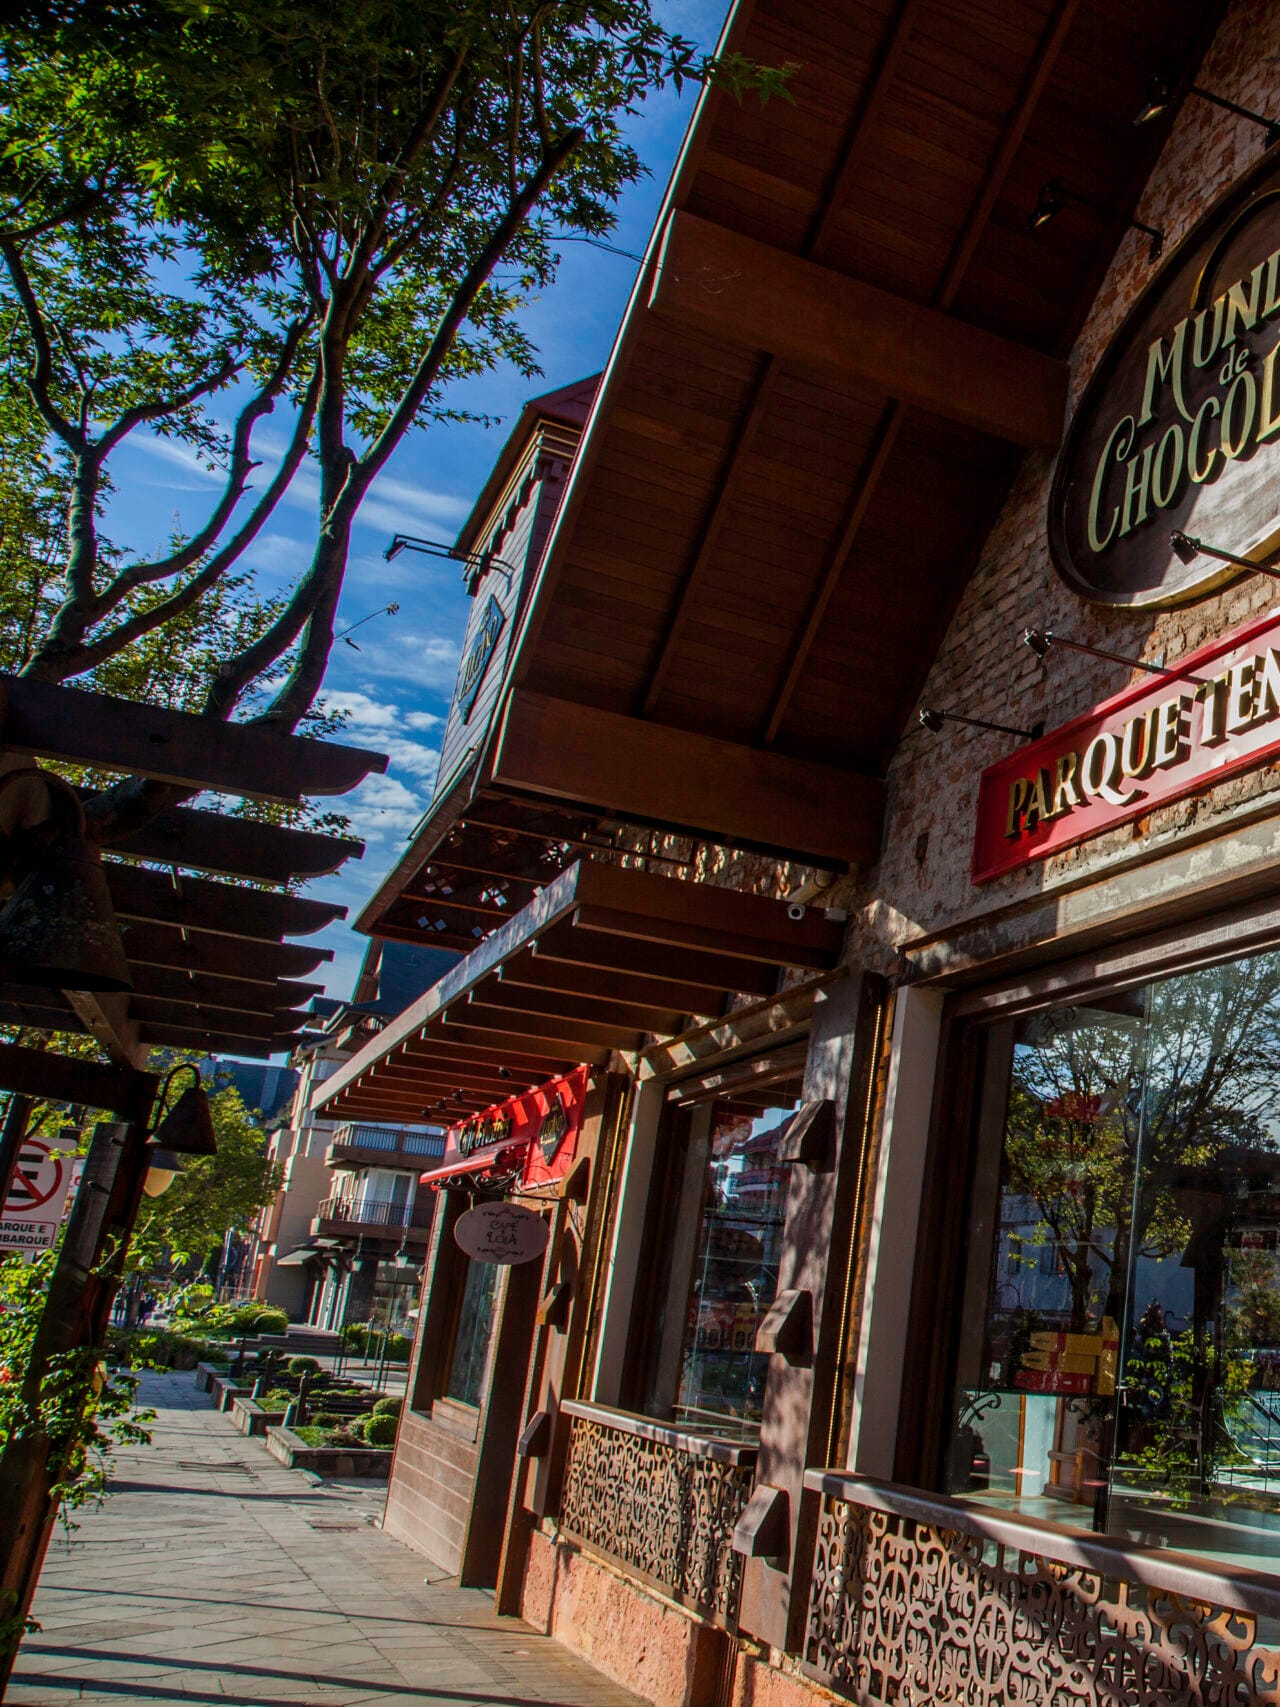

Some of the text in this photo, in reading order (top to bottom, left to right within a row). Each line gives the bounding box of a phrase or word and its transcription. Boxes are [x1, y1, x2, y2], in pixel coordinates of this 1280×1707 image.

[1219, 343, 1249, 386] de
[1004, 694, 1182, 837] PARQUE
[38, 1224, 47, 1234] E
